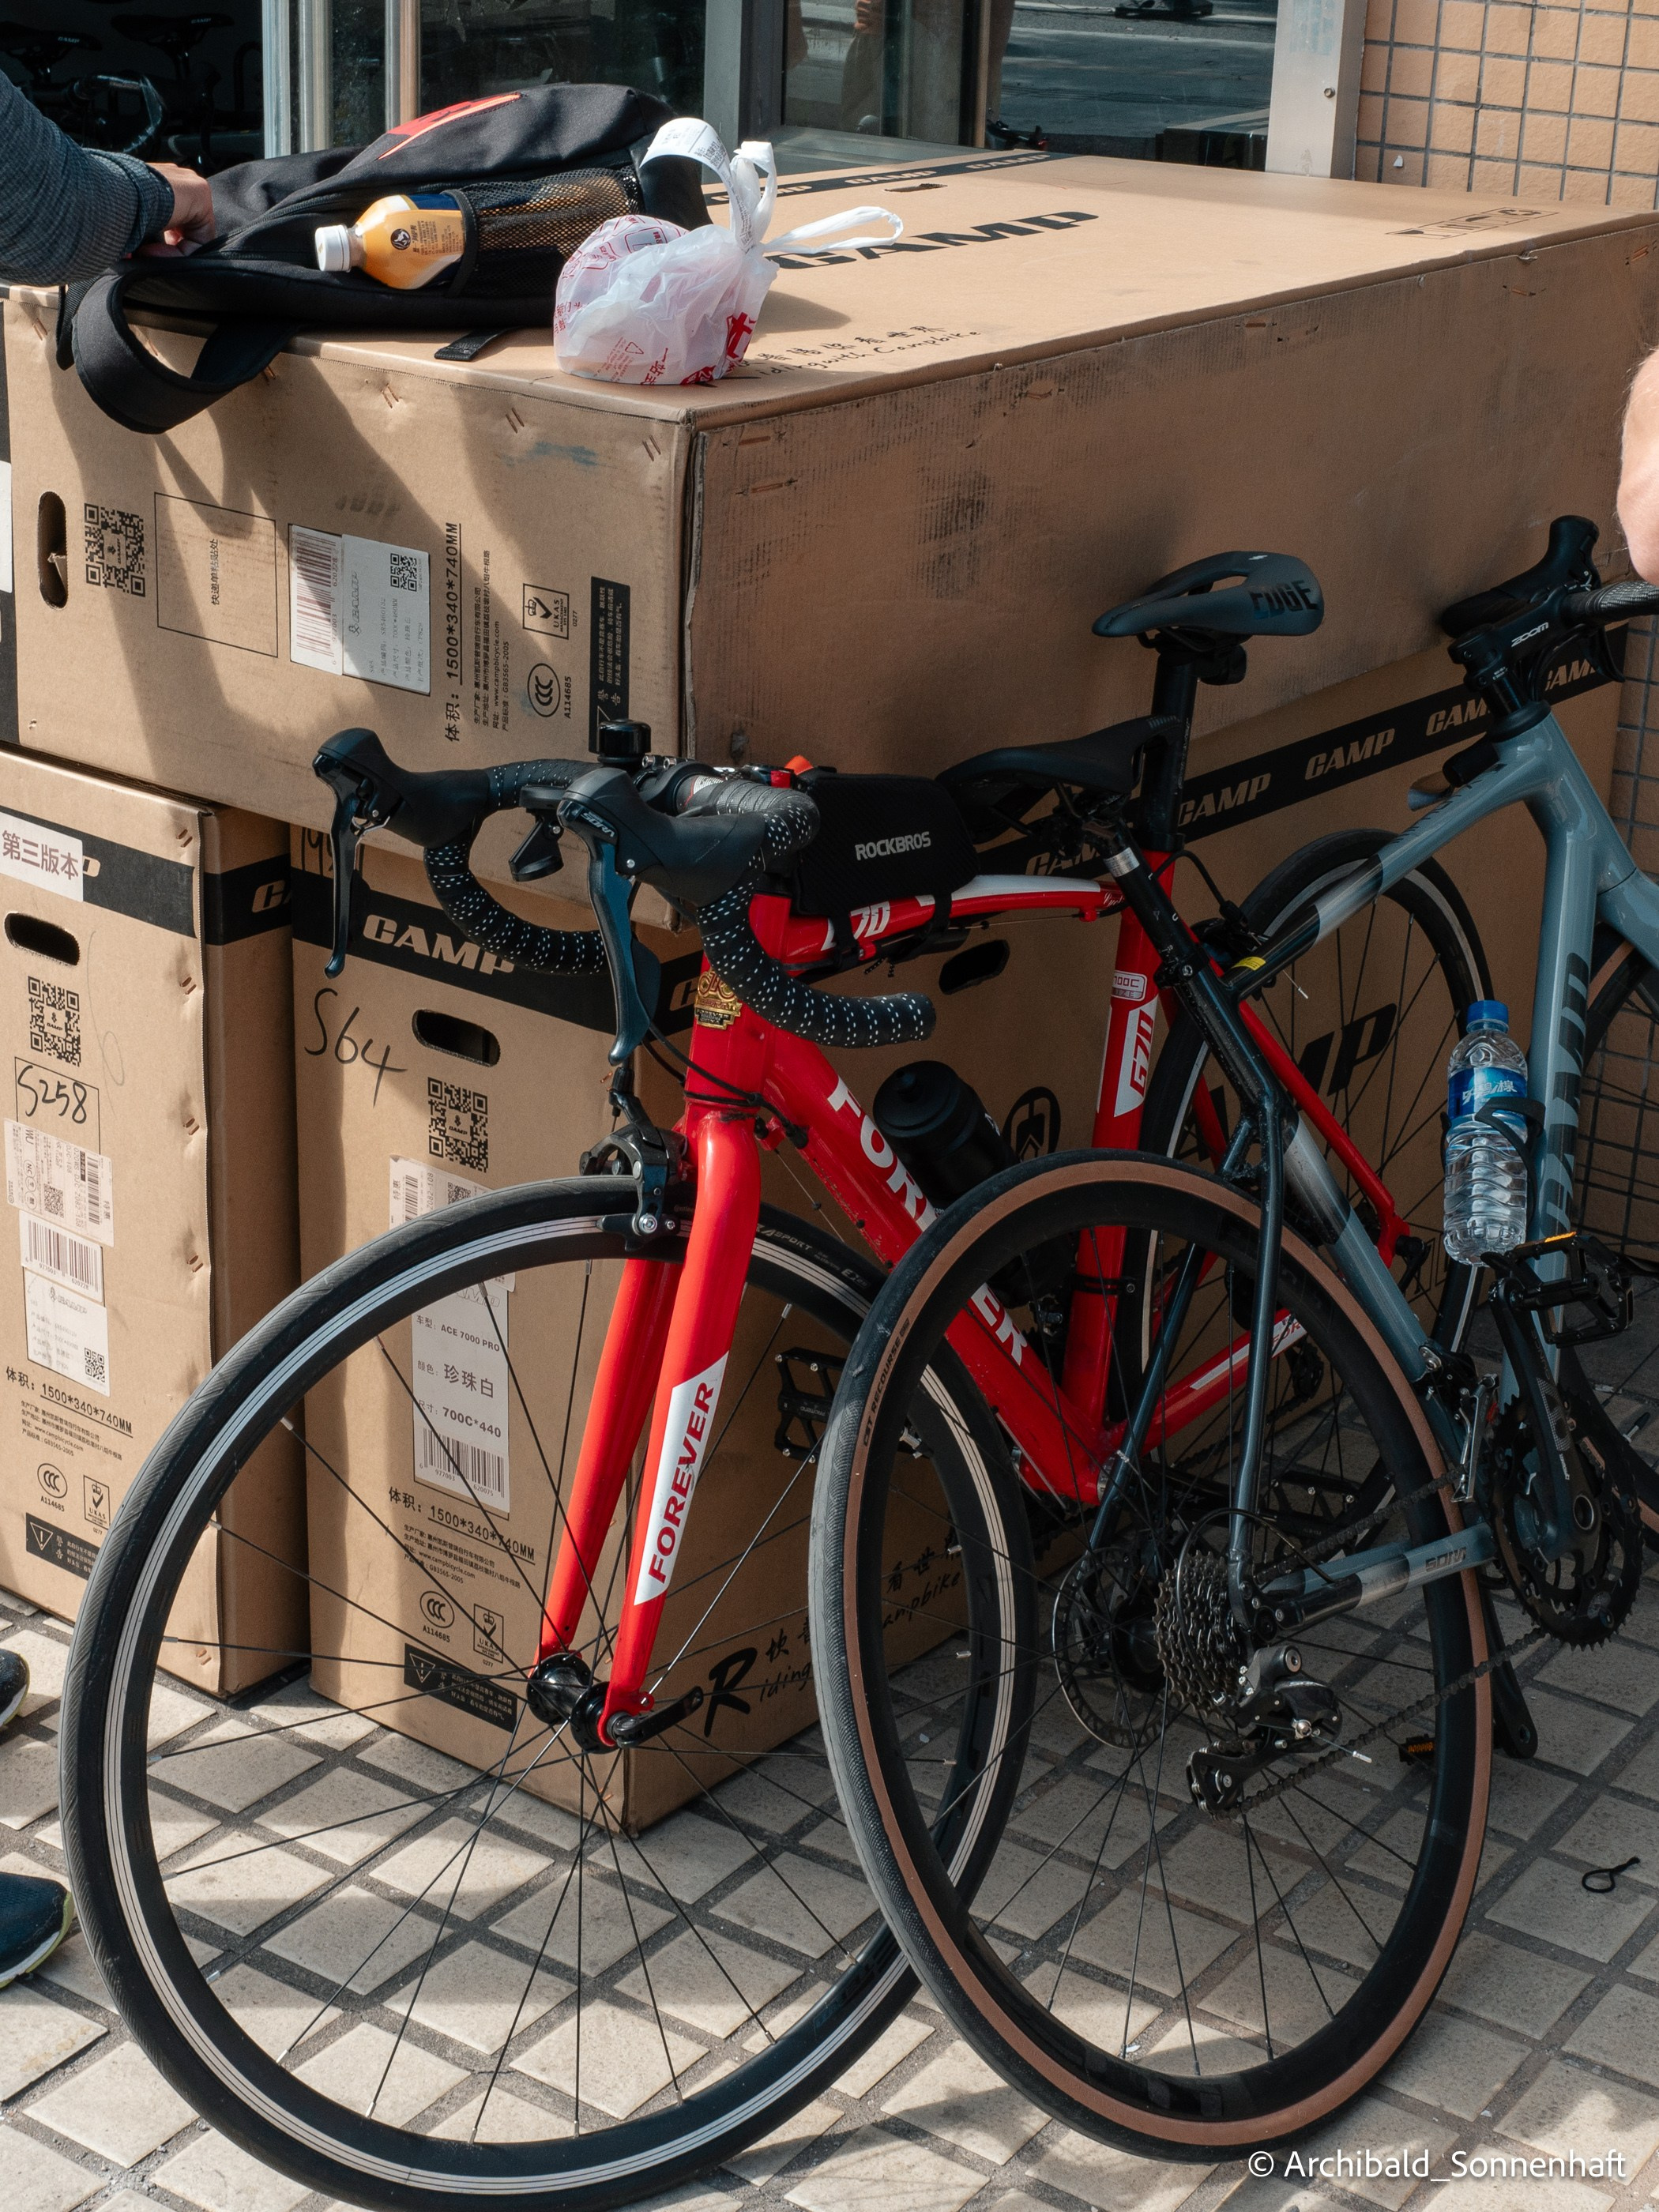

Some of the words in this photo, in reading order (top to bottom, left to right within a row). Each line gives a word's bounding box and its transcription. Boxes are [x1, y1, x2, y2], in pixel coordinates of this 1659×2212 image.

[965, 155, 1051, 170] CAMP
[845, 171, 937, 185] CAMP
[766, 211, 1099, 269] CAMP
[210, 538, 220, 606] 快递单粘贴处
[1249, 579, 1319, 620] EDGE
[1425, 696, 1491, 737] CAM
[1304, 728, 1395, 781] CAMP
[1178, 773, 1270, 827] CAMP
[2, 832, 80, 881] 第三版本
[855, 831, 931, 862] ROCKBROS
[304, 988, 408, 1108] S64
[1130, 1009, 1154, 1097] G70
[17, 1065, 88, 1124] S258
[393, 1179, 401, 1201] 特惠
[773, 1232, 813, 1251] SPORT
[441, 1325, 457, 1337] ACE
[461, 1331, 480, 1345] 7000
[482, 1339, 500, 1352] PRO
[6, 1366, 35, 1391] 体积：
[444, 1364, 494, 1398] 珍珠白
[871, 1337, 901, 1414] RECOURSE
[35, 1425, 84, 1452] www.campbicycle.com
[44, 1438, 74, 1457] GB3565-2005
[434, 1469, 456, 1482] 977003
[473, 1484, 494, 1497] 620075
[648, 1382, 714, 1585] FOREVER
[40, 1495, 65, 1512] A114685
[89, 1507, 106, 1520] UKAS
[389, 1486, 421, 1514] 体积：
[419, 1551, 476, 1579] www.campbicycle.com
[429, 1564, 464, 1584] GB3565-2005
[882, 1571, 961, 1630] ampbike
[423, 1625, 450, 1642] A114685
